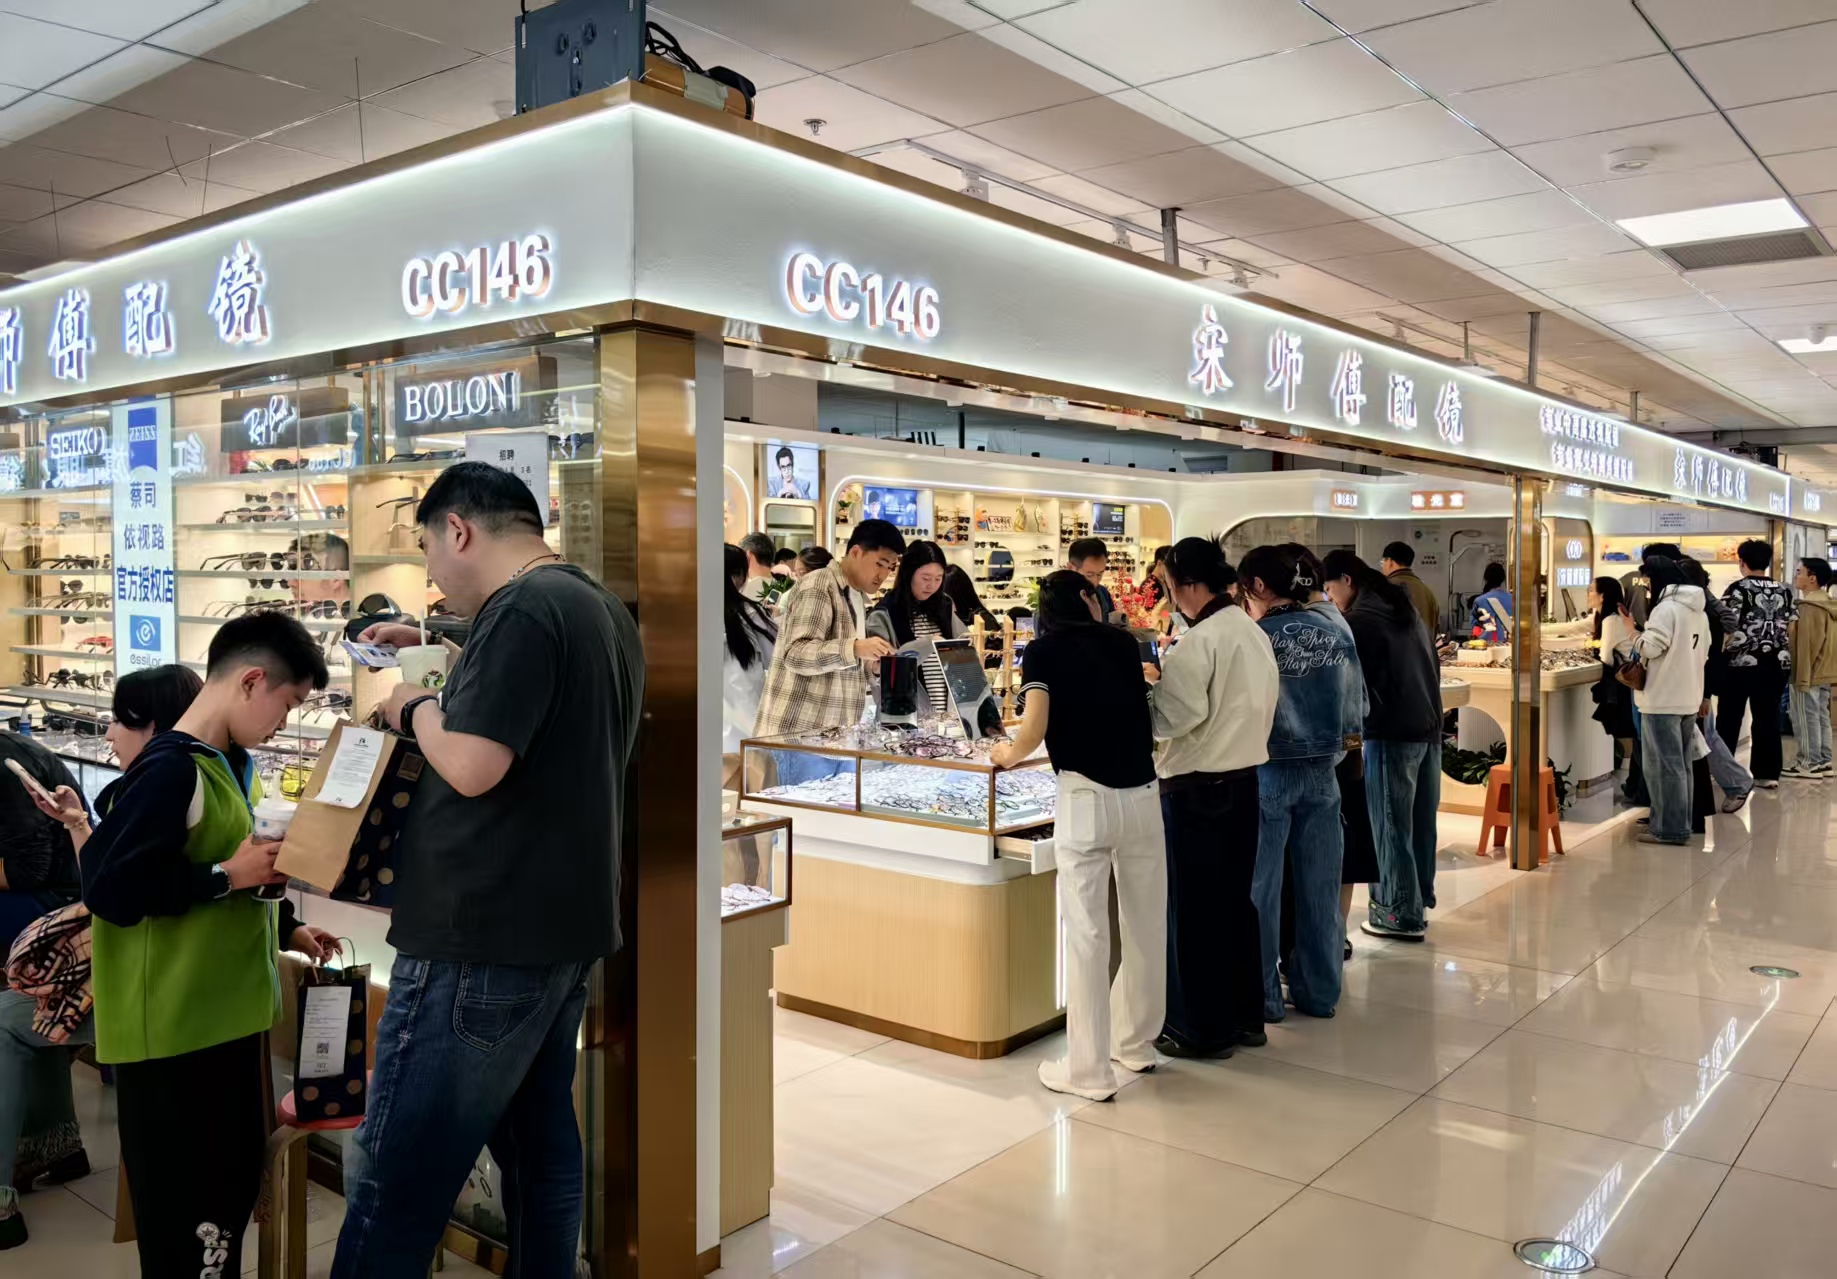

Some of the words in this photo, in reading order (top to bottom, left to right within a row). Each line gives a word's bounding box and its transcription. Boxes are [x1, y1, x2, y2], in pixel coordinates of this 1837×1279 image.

[402, 233, 554, 318] CC146
[785, 252, 940, 339] CC146
[404, 371, 520, 424] BOLON
[50, 426, 106, 459] SEIKO
[129, 424, 157, 441] ZEISS
[130, 481, 156, 508] 蔡司
[123, 523, 165, 551] 依视路
[116, 565, 174, 604] 官方授权店
[1692, 633, 1699, 649] 7
[130, 653, 162, 667] essilor
[1277, 652, 1308, 676] Stay
